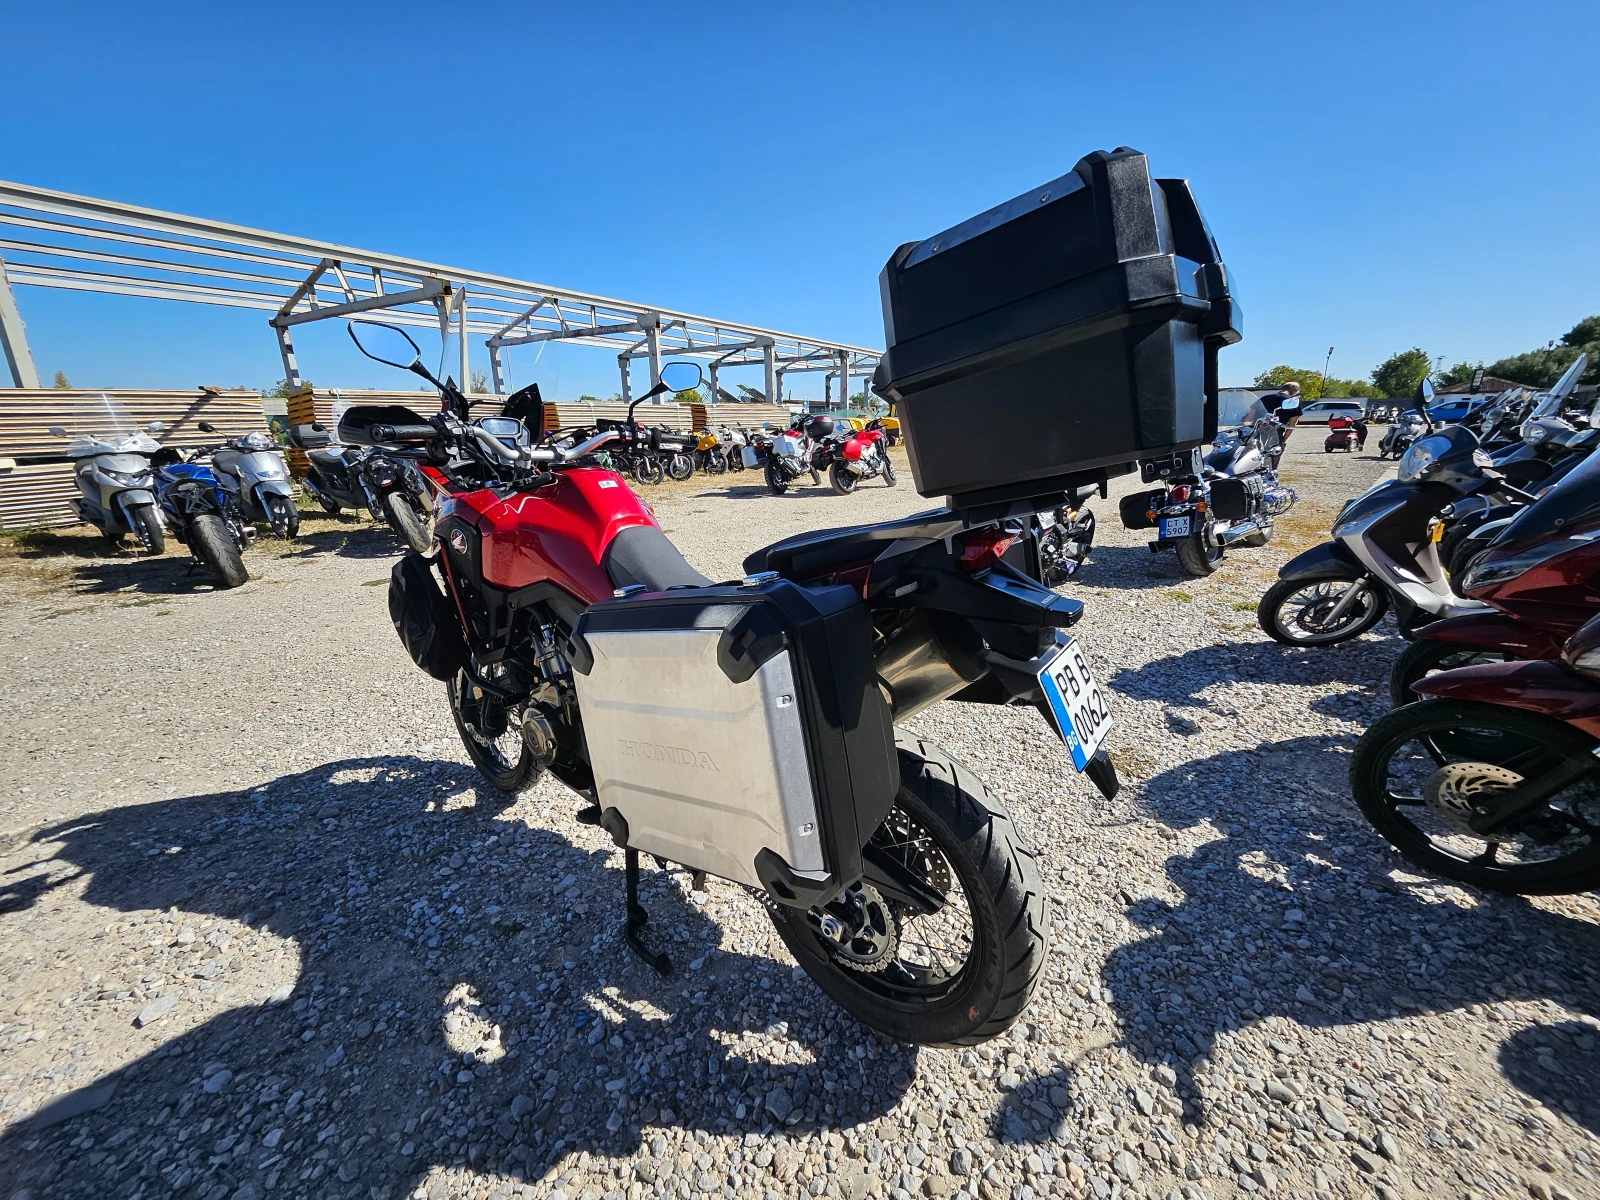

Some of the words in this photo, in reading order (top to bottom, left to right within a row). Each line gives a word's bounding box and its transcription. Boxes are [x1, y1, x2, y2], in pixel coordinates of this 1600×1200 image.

[1167, 526, 1188, 536] 5907
[1055, 664, 1080, 707] PB
[1074, 653, 1091, 685] B
[1073, 688, 1109, 744] 0062
[619, 739, 720, 771] HONDA
[1066, 732, 1078, 751] BG
